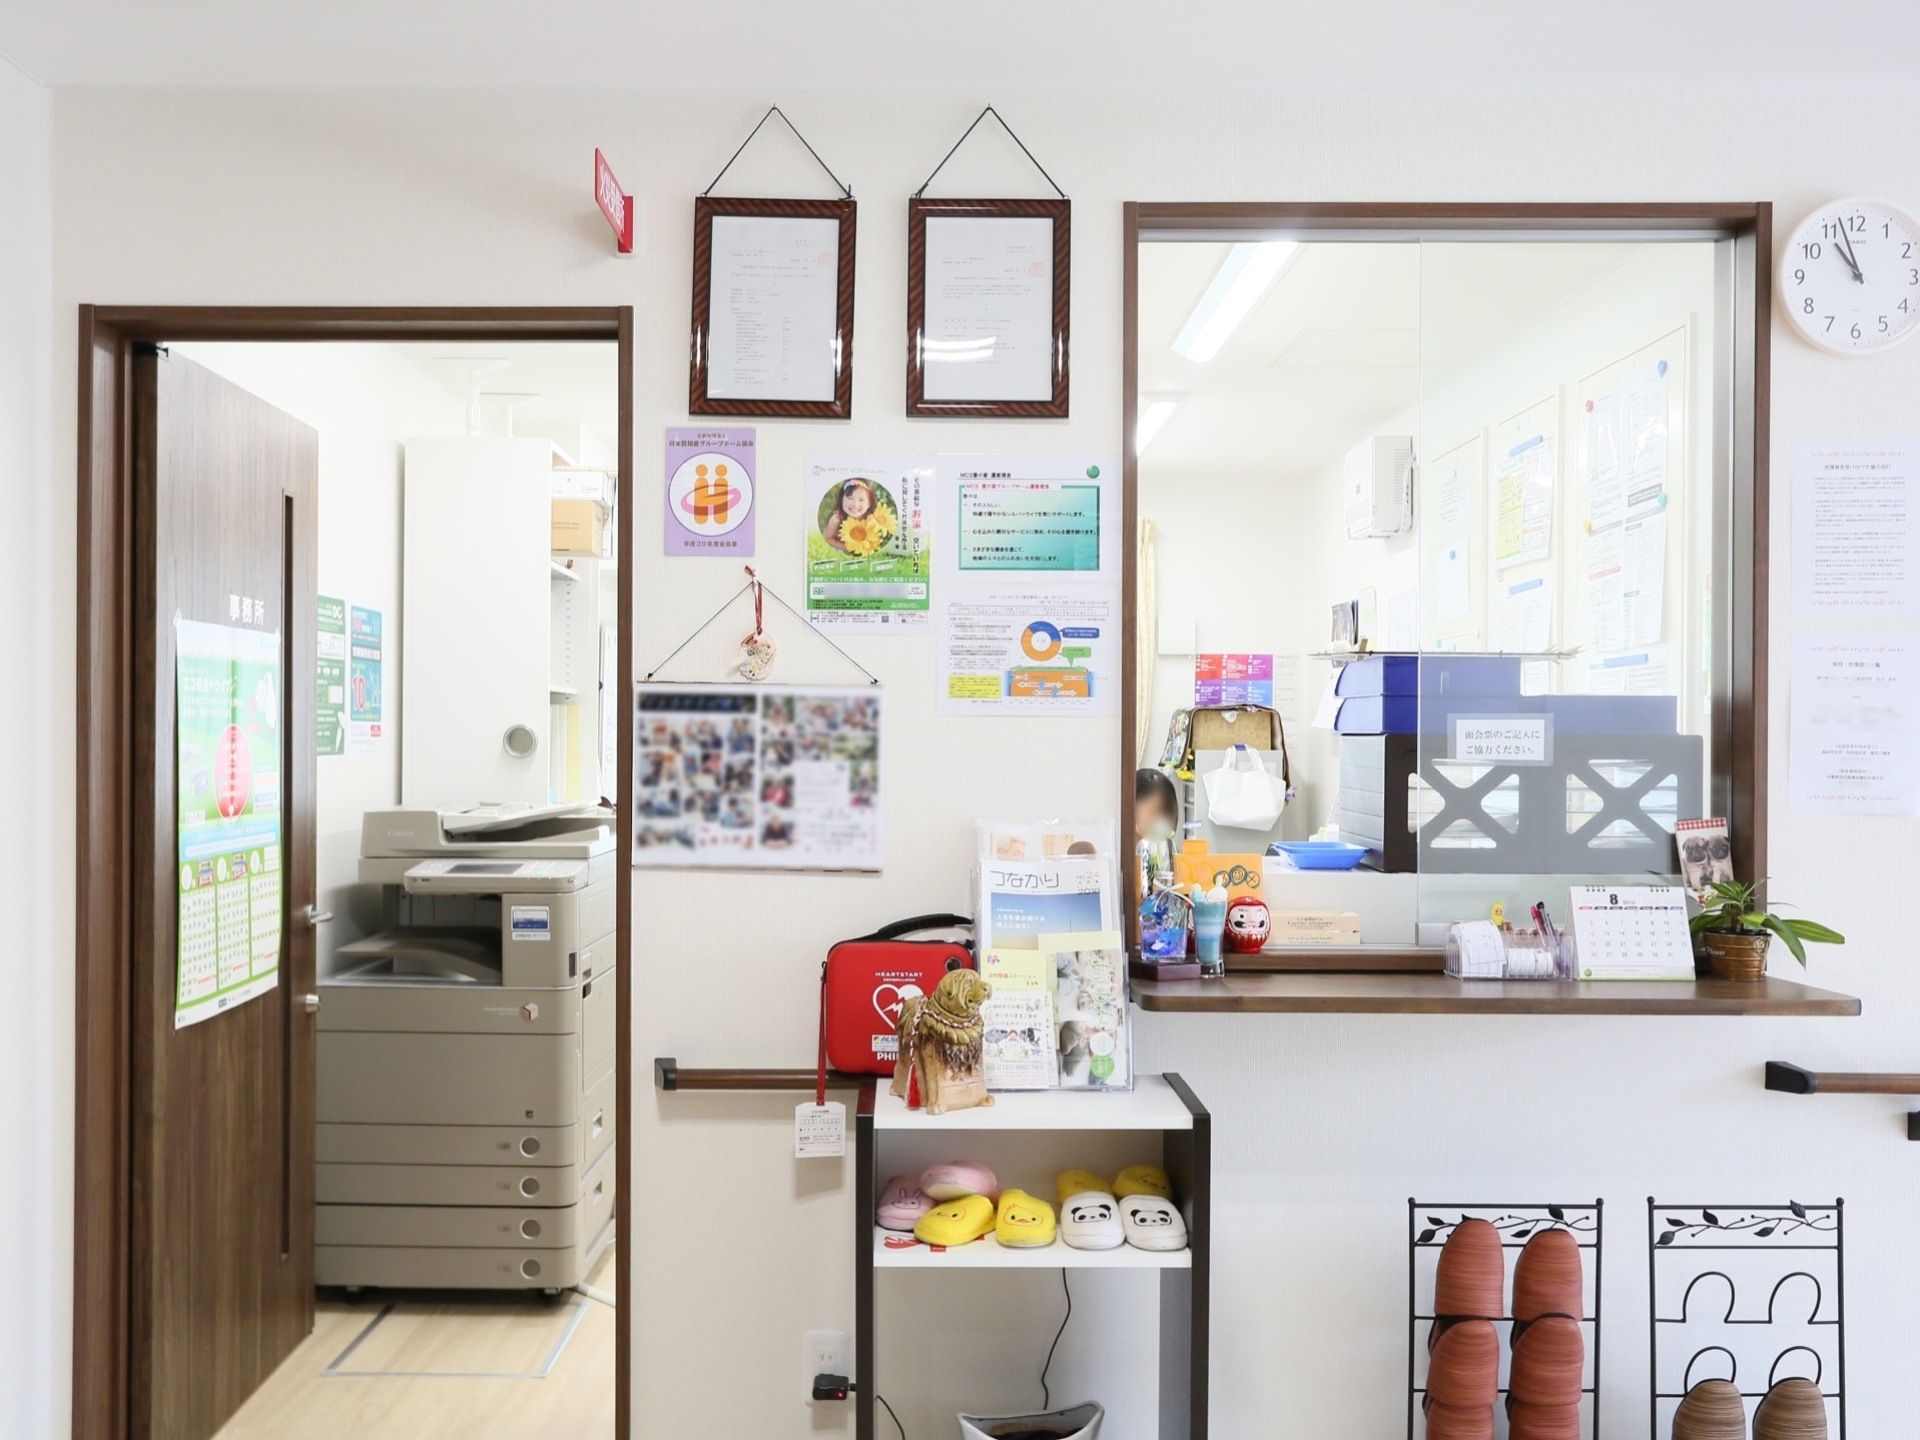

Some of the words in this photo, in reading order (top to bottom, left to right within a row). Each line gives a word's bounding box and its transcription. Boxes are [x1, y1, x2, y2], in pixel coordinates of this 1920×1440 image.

[1822, 223, 1837, 239] 11
[1847, 215, 1867, 232] 12
[1882, 222, 1889, 239] 1
[1802, 242, 1822, 260] 10
[1901, 242, 1912, 259] 2
[1794, 269, 1805, 286] 9
[1909, 269, 1919, 285] 3
[1804, 297, 1814, 314] 8
[1897, 297, 1909, 314] 4
[1824, 315, 1835, 332] 7
[1851, 322, 1861, 339] 6
[1878, 315, 1888, 332] 5
[229, 594, 265, 626] 事務所
[1464, 729, 1541, 740] 面会票のご記入に
[1465, 744, 1535, 755] ご協力ください。
[990, 869, 1059, 889] つながり
[1609, 893, 1618, 905] 8
